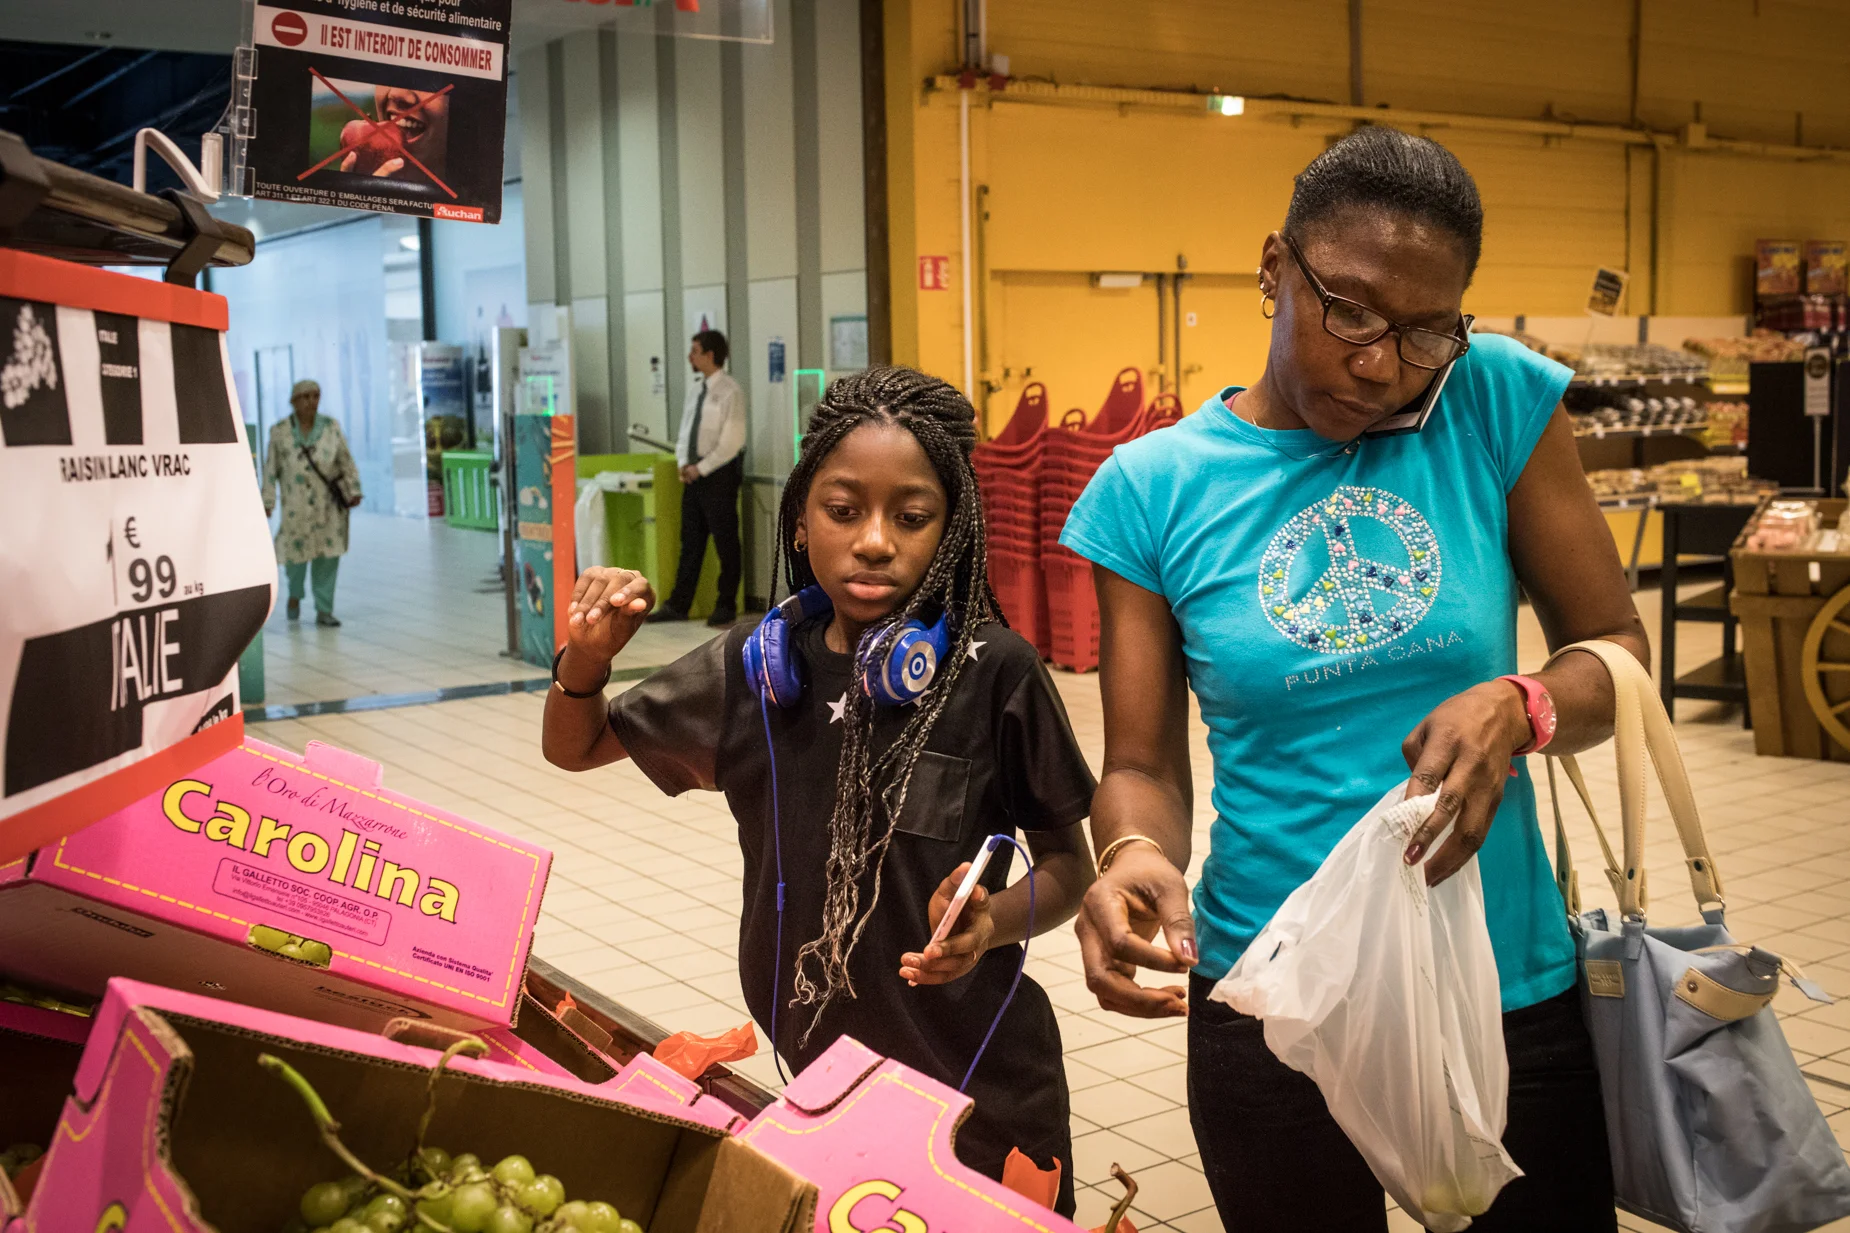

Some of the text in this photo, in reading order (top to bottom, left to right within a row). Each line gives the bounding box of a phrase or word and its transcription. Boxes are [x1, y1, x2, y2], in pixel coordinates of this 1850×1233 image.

[380, 3, 390, 13] et
[392, 2, 404, 15] de
[407, 5, 446, 22] sécurité
[448, 11, 502, 31] alimentaire
[331, 26, 352, 49] EST
[354, 29, 405, 58] INTERDIT
[407, 38, 422, 60] DE
[425, 41, 492, 71] CONSOMMER
[256, 182, 281, 191] TOUTE
[283, 186, 329, 197] OUVERTURE
[389, 198, 408, 206] SERA
[337, 199, 348, 207] DU
[350, 200, 371, 210] CODE
[438, 206, 482, 221] Auchan
[152, 454, 191, 477] VRAC
[128, 554, 177, 603] 99
[194, 580, 204, 596] kg
[1285, 630, 1464, 691] PUNTA CANA
[301, 787, 328, 807] di
[161, 779, 460, 924] Carolina
[232, 865, 240, 874] IL
[242, 869, 289, 890] GALLETTO
[291, 884, 311, 897] SOC.
[313, 892, 339, 907] COOP.
[340, 901, 361, 914] AGR.
[412, 946, 435, 958] Azienda
[448, 957, 470, 969] Sistema
[412, 953, 442, 967] Certificato
[443, 963, 454, 971] UNI
[455, 966, 463, 974] EN
[465, 969, 474, 977] ISO
